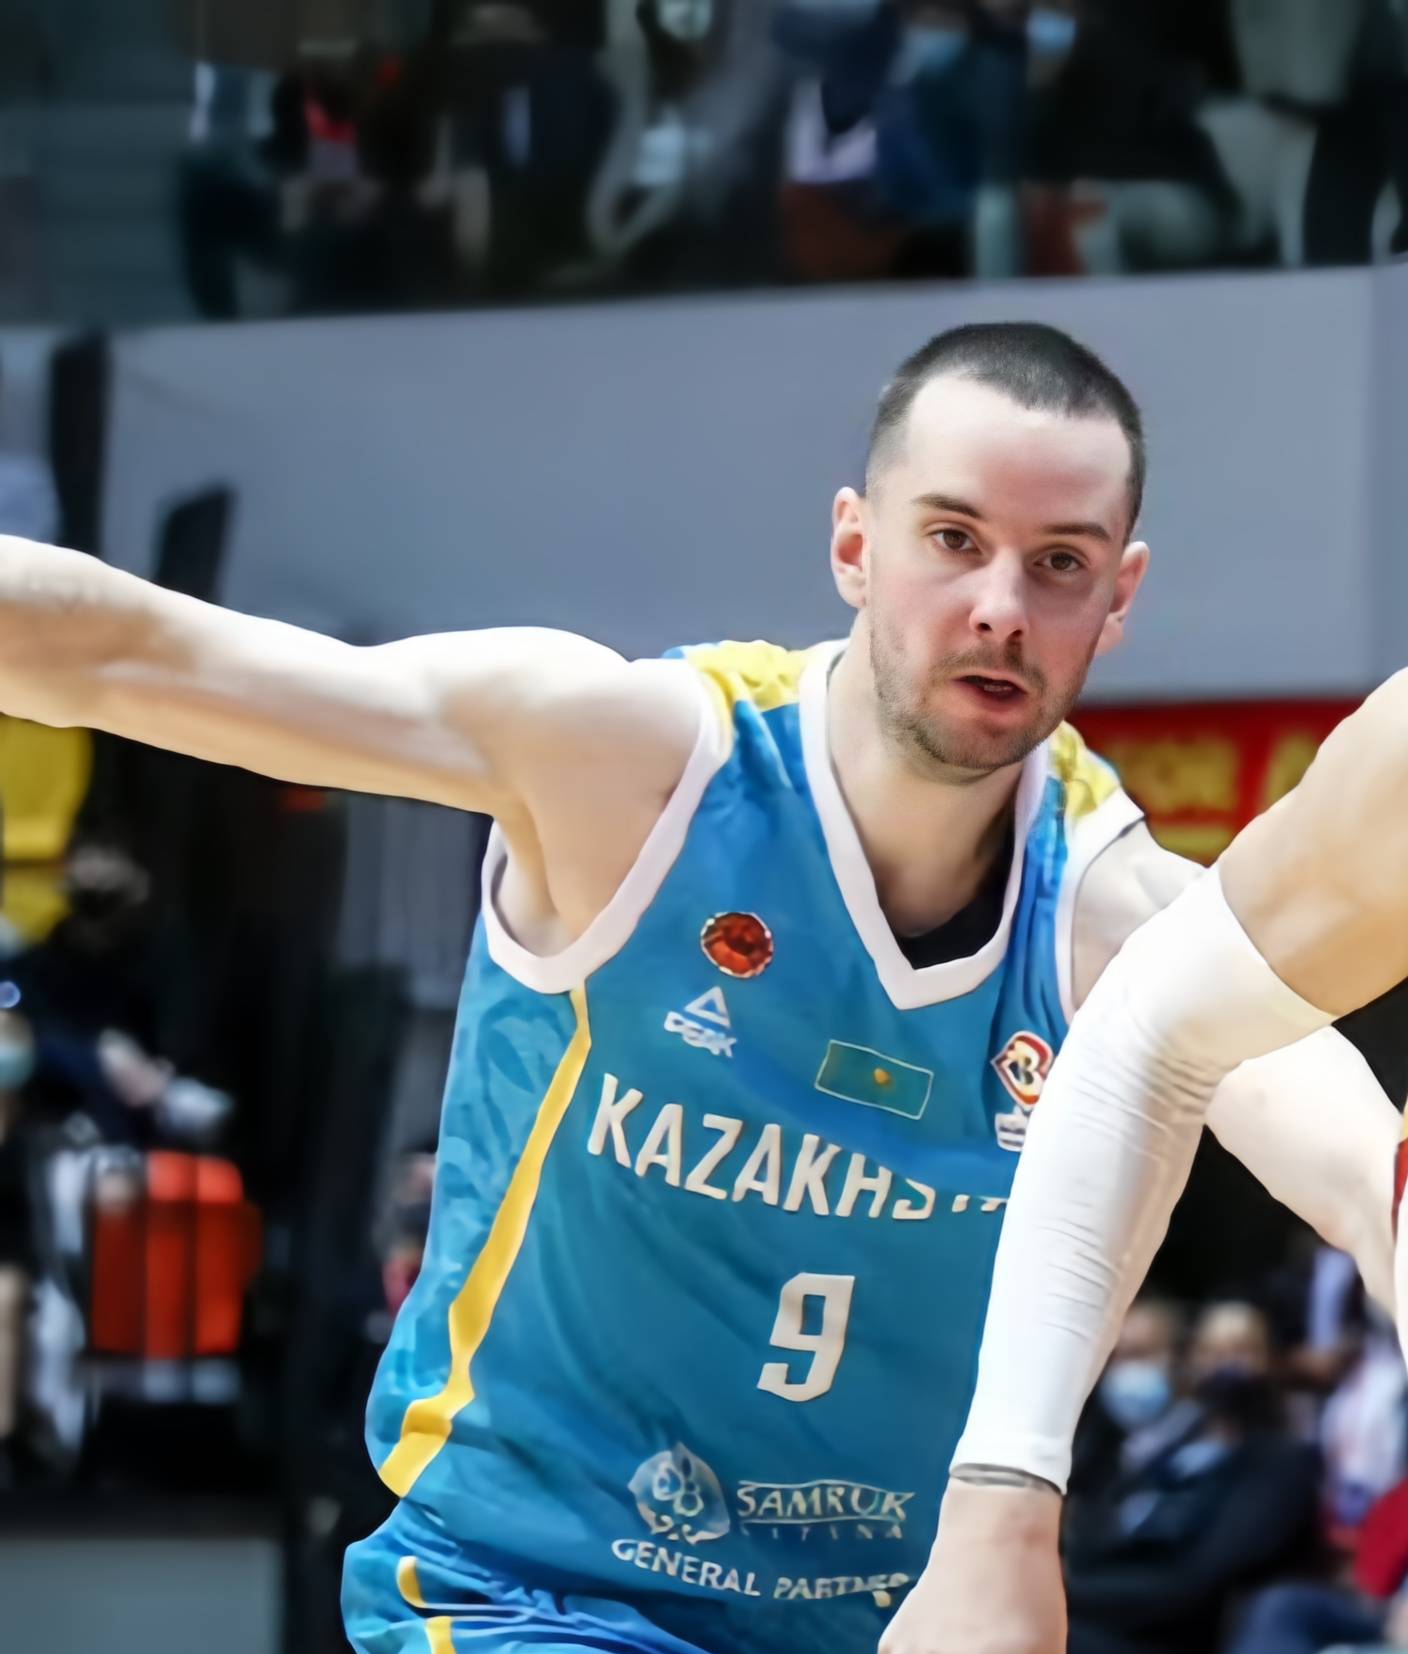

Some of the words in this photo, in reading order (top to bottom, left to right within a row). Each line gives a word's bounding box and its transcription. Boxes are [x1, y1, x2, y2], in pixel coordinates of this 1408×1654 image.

[586, 1072, 1007, 1221] KAZAKHS
[756, 1271, 856, 1403] 9
[736, 1483, 917, 1522] SAMRUK
[610, 1537, 762, 1598] GENERAL
